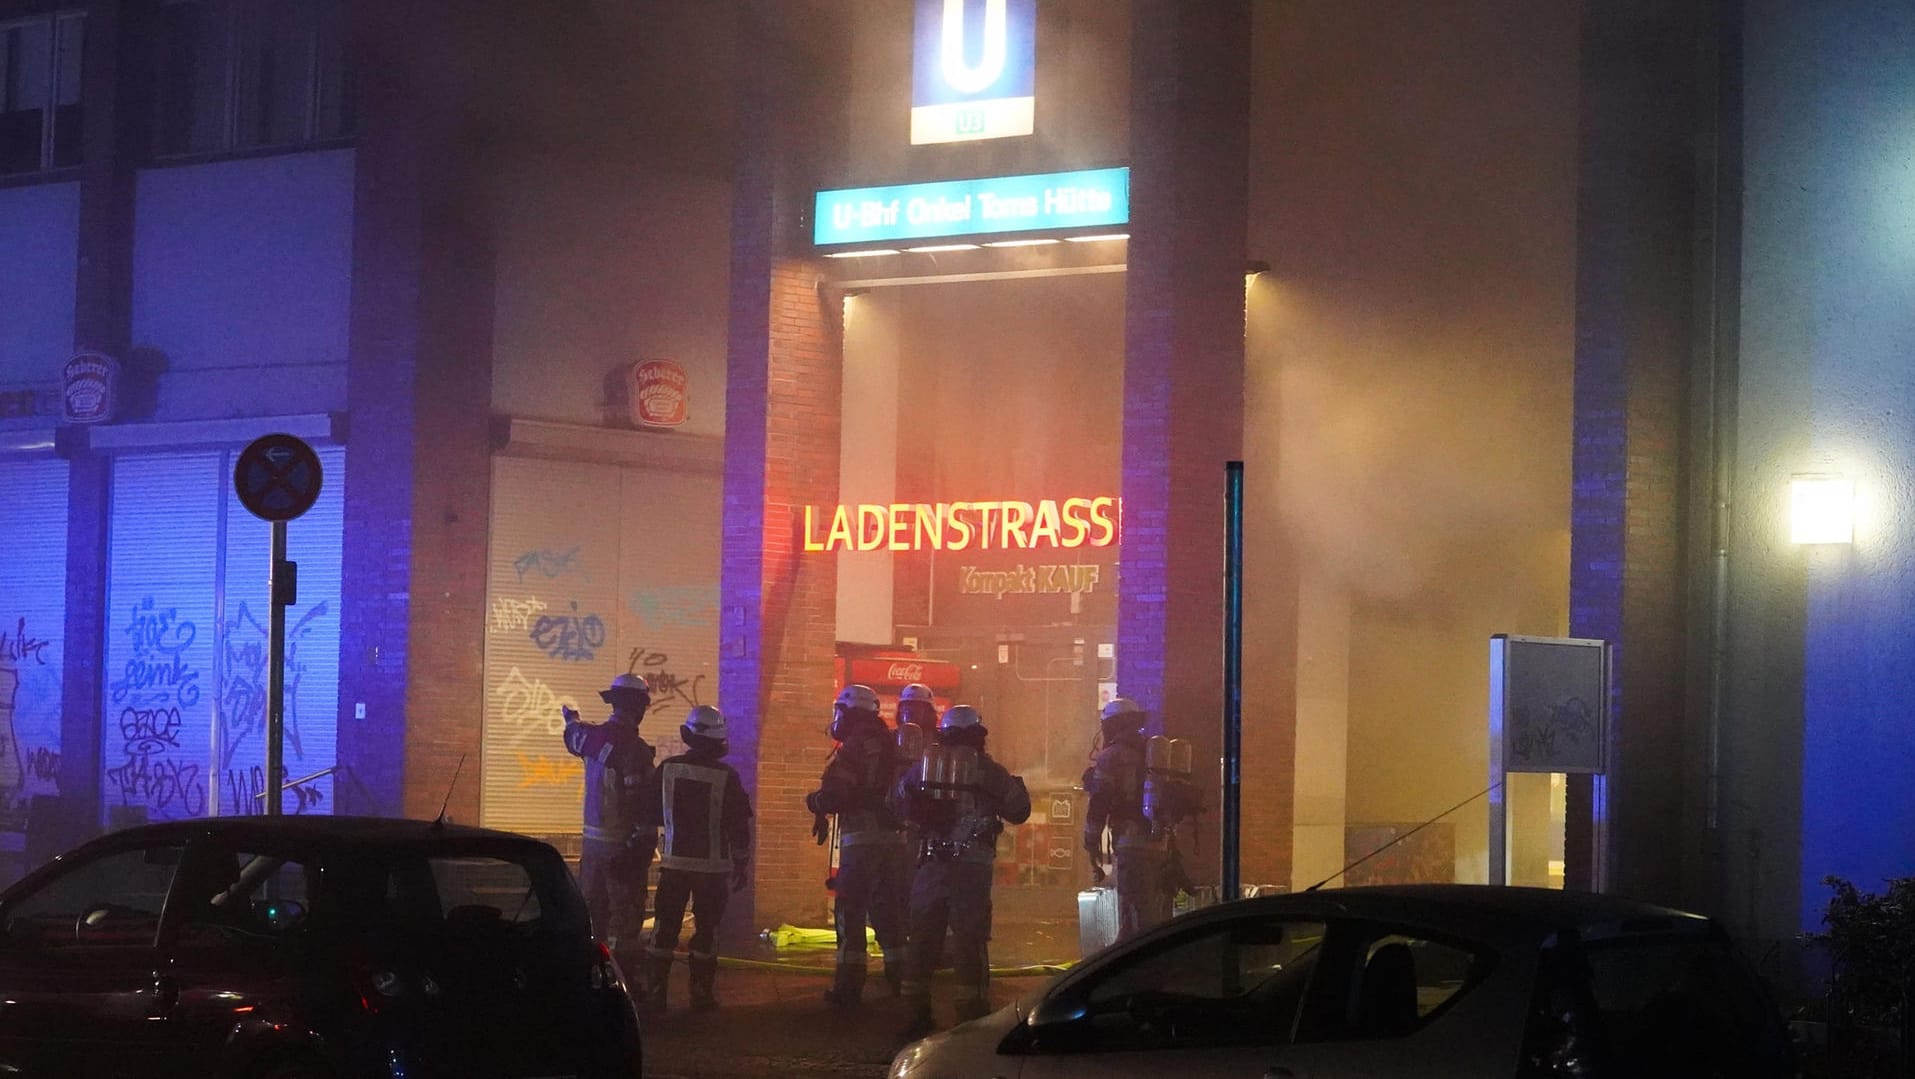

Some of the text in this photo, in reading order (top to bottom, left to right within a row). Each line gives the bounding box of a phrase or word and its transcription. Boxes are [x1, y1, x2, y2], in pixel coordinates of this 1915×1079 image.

[942, 0, 1007, 94] U
[907, 194, 972, 225] Onkel
[977, 191, 1037, 220] Toms
[1044, 187, 1112, 215] Hütte
[803, 496, 1122, 552] LADENSTRASS
[960, 565, 1100, 600] Kompakt KAUF
